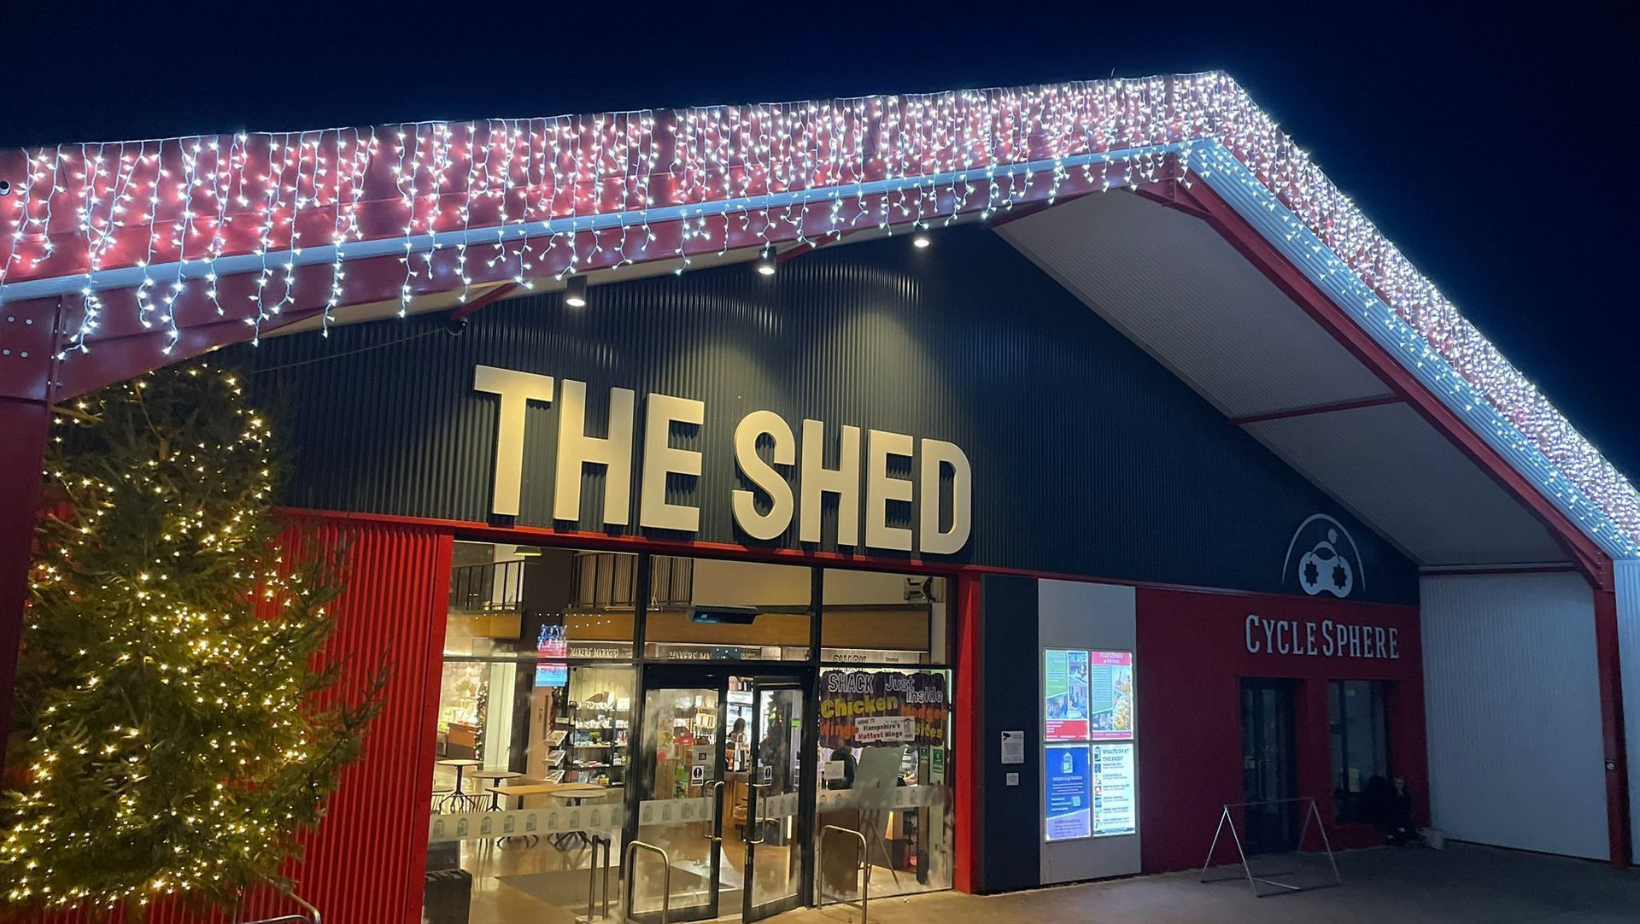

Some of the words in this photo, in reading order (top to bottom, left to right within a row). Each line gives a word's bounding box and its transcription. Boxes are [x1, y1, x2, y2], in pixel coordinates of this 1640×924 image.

[474, 364, 704, 532] THE
[732, 409, 972, 555] SHED
[828, 673, 874, 693] SHACK
[885, 675, 915, 692] Just
[906, 688, 944, 703] Inside
[820, 694, 899, 719] Chicken
[858, 732, 884, 741] Hottest
[885, 731, 903, 739] Wings
[863, 723, 901, 733] Hampshire's
